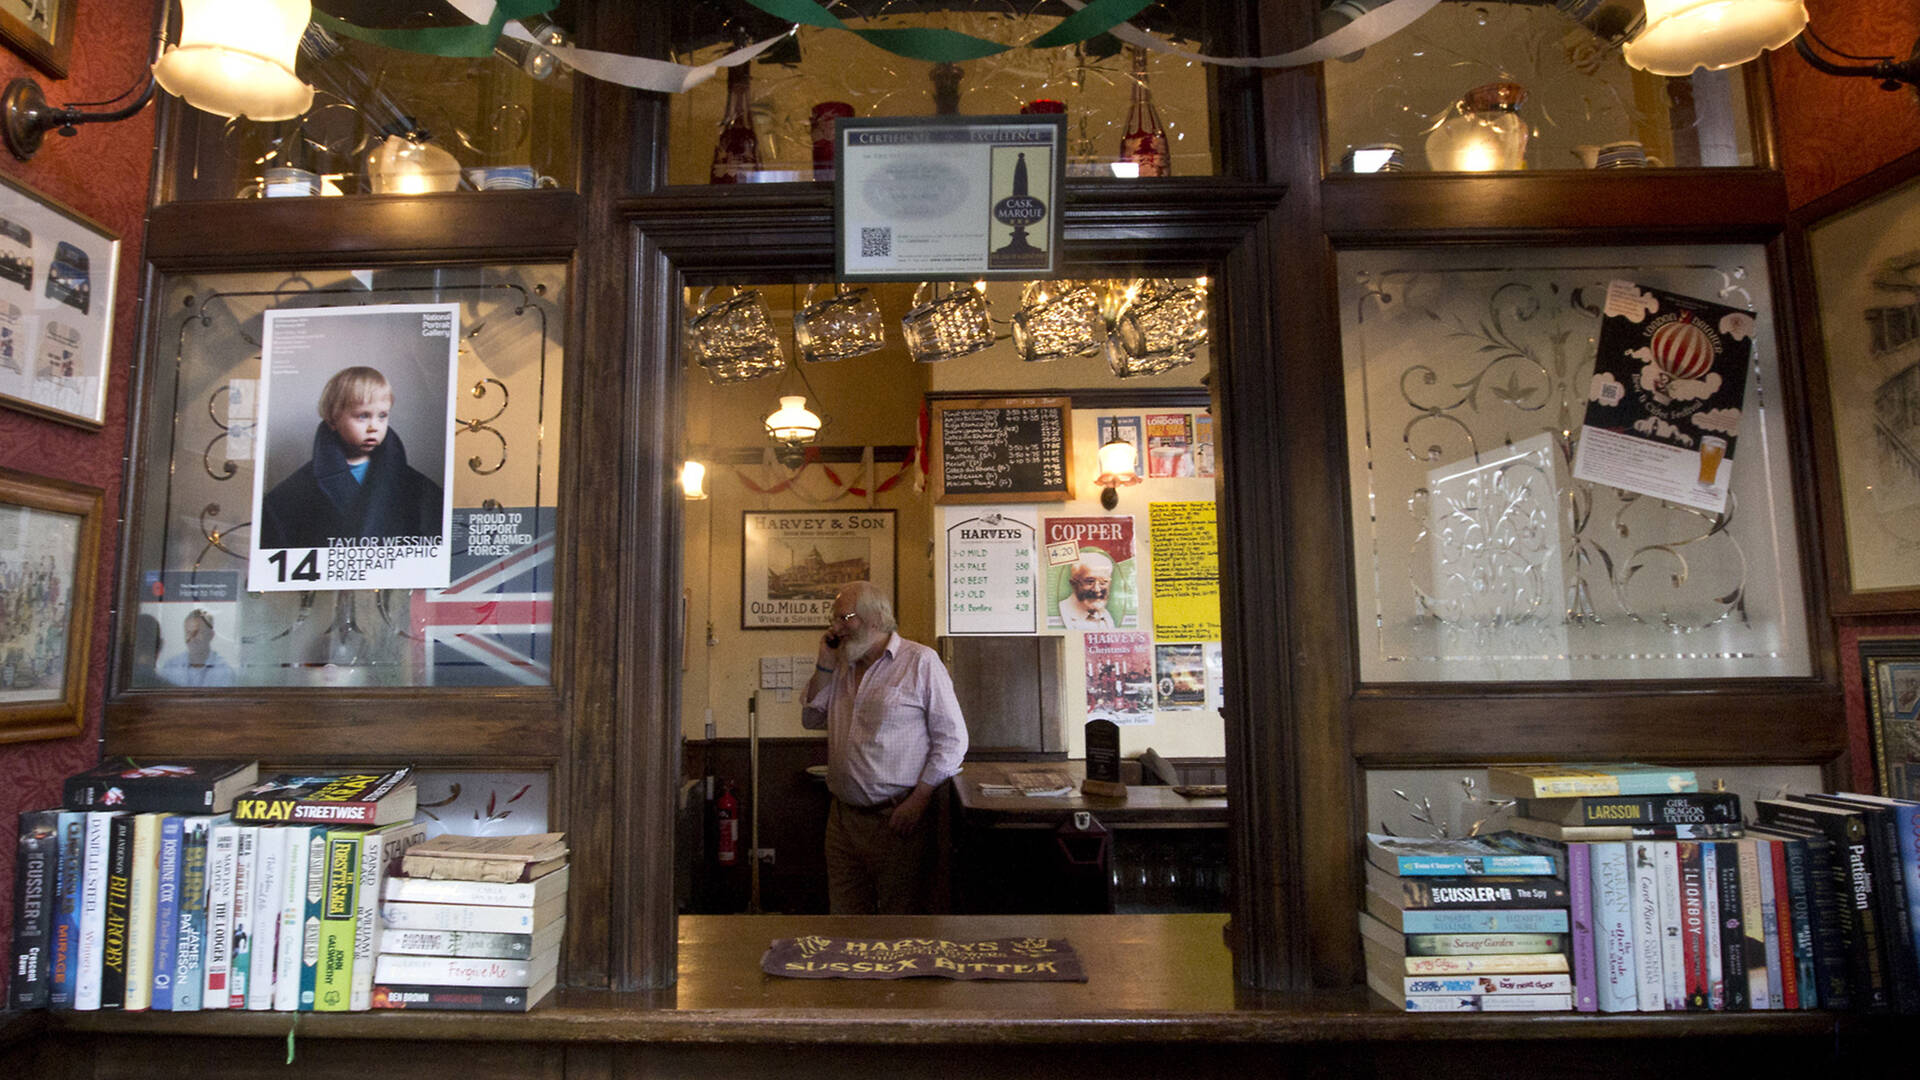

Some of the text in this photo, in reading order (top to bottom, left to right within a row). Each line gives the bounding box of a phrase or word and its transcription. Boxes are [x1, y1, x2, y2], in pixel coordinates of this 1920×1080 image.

[970, 129, 1041, 141] EXCELLENCE
[999, 208, 1043, 218] MARQUE
[1006, 200, 1033, 208] CASK
[422, 329, 450, 338] Gallery
[469, 513, 522, 524] PROUD TO
[755, 516, 885, 530] HARVEY & SON
[468, 524, 518, 534] SUPPORT
[961, 529, 1022, 539] HARVEYS
[1051, 523, 1123, 541] COPPER
[327, 535, 443, 548] TAYLOR WESSING
[469, 534, 532, 545] OUR ARMED
[328, 547, 438, 559] PHOTOGRAPHIC
[967, 549, 987, 557] MILD
[268, 549, 321, 582] 14
[328, 559, 395, 570] PORTRAIT
[967, 563, 987, 571] PALE
[327, 570, 366, 581] PRIZE
[809, 603, 818, 614] &
[240, 800, 366, 820] KRAY STREETWISE
[1588, 805, 1640, 819] LARSSON
[1663, 806, 1704, 815] DRAGON
[1666, 799, 1688, 808] GIRL
[1664, 815, 1705, 823] TATTOO
[88, 818, 102, 873] DANIELLE
[160, 839, 178, 903] JOSEPHINE COX
[222, 854, 232, 878] MARY
[366, 844, 378, 886] STAINED
[183, 847, 206, 911] BURN
[330, 843, 351, 913] FORSYTE SAGA
[1601, 861, 1615, 907] KEYES
[1610, 853, 1629, 913] MARIAN
[1849, 845, 1869, 910] Patterson
[24, 861, 44, 919] CUSSLER
[1440, 887, 1496, 902] CUSSLER
[1517, 889, 1531, 898] The
[1532, 889, 1547, 899] Spy
[1641, 877, 1654, 903] Carol
[1791, 856, 1808, 919] COMPTON
[1685, 874, 1702, 935] LIONBOY
[105, 874, 128, 973] BILLAROOBY
[213, 902, 226, 962] THE LODGER
[361, 908, 374, 954] WILLIAM
[178, 914, 192, 985] PATTERSON
[188, 928, 201, 970] JAMES
[846, 938, 999, 952] HARVEYS
[1454, 939, 1483, 950] Savage
[1484, 938, 1514, 948] Garden
[54, 924, 70, 984] MIRAGE
[325, 935, 336, 985] GALSWORTHY
[334, 950, 345, 971] JOHN
[18, 954, 30, 976] Dawn
[27, 946, 41, 982] Crescent
[448, 962, 508, 981] Forgive Me
[785, 957, 1058, 974] SUSSEX BITTER
